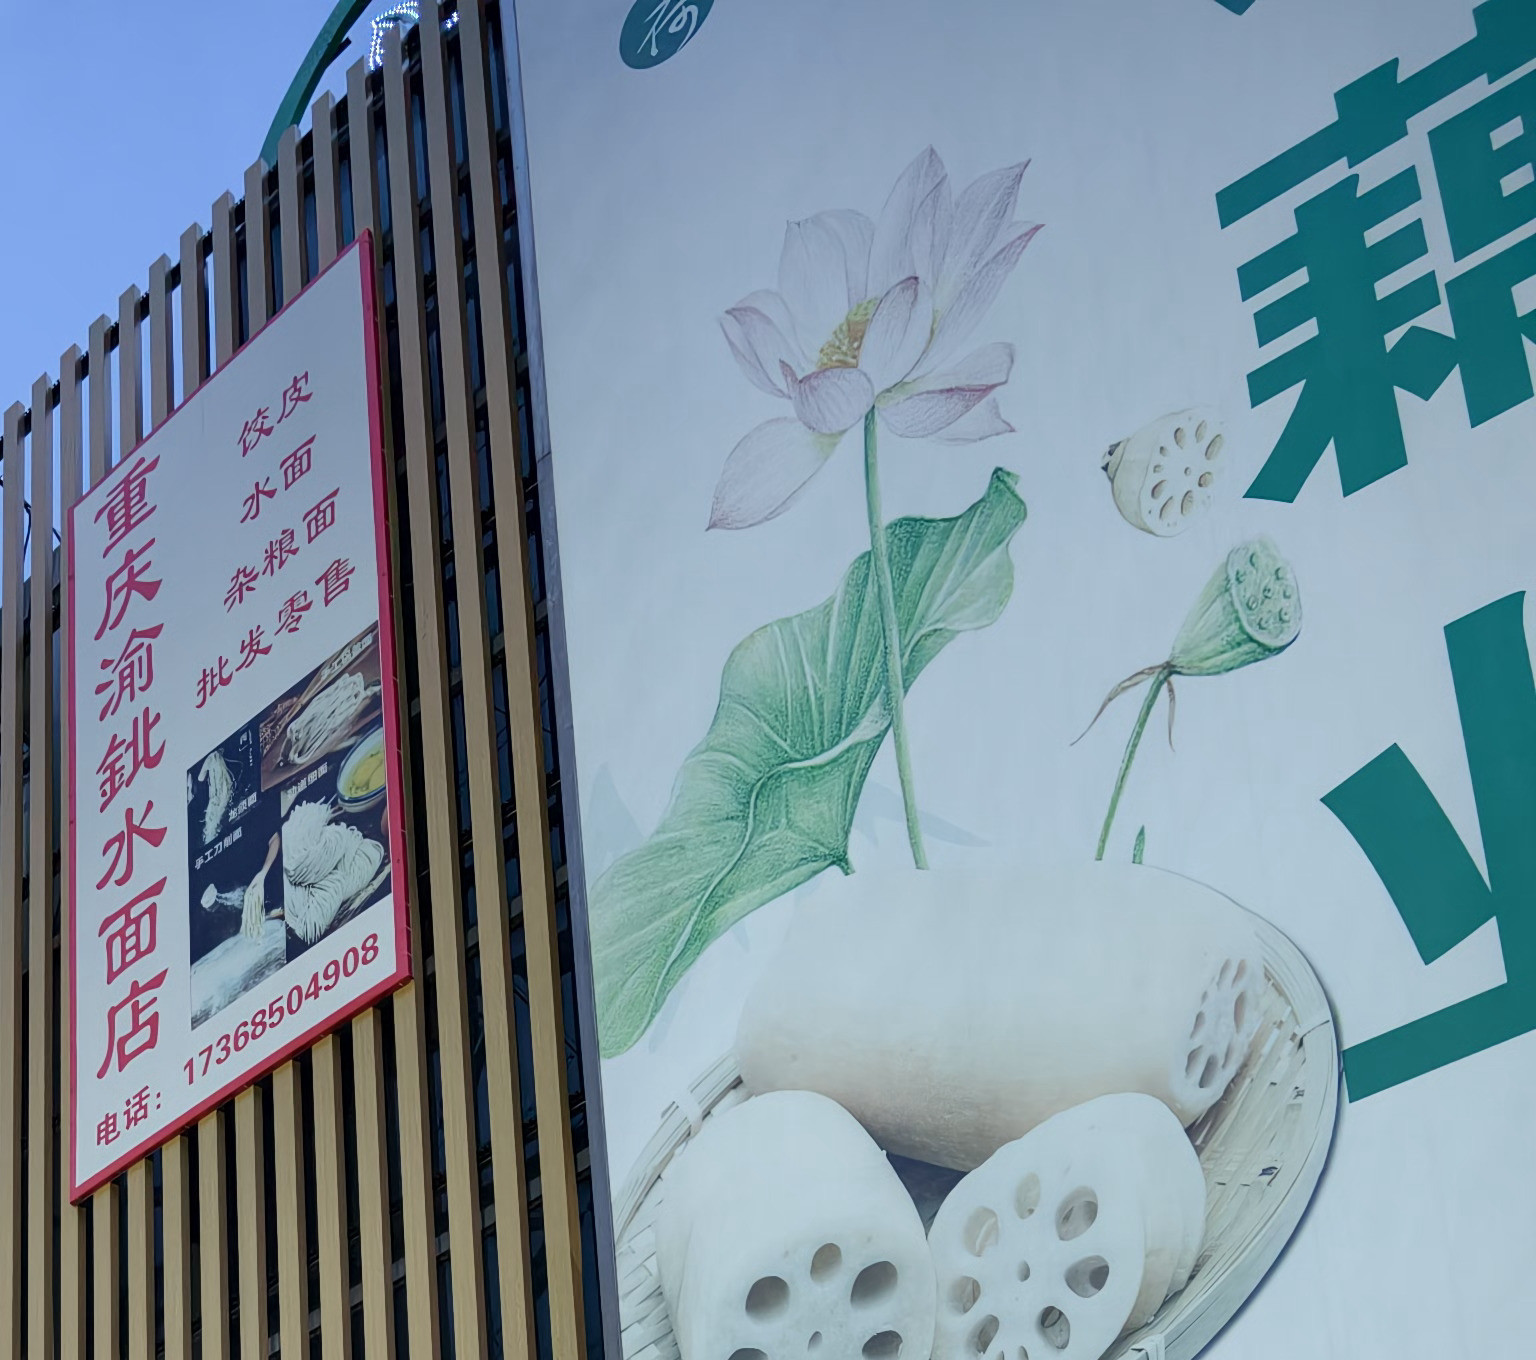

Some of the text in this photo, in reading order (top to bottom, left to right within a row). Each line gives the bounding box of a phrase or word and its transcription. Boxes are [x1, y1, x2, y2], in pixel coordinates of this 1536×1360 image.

[237, 370, 314, 458] 饺皮
[240, 434, 317, 524] 水面
[223, 486, 340, 613] 杂粮面
[195, 558, 356, 709] 批发零售
[183, 933, 380, 1086] 17368504908
